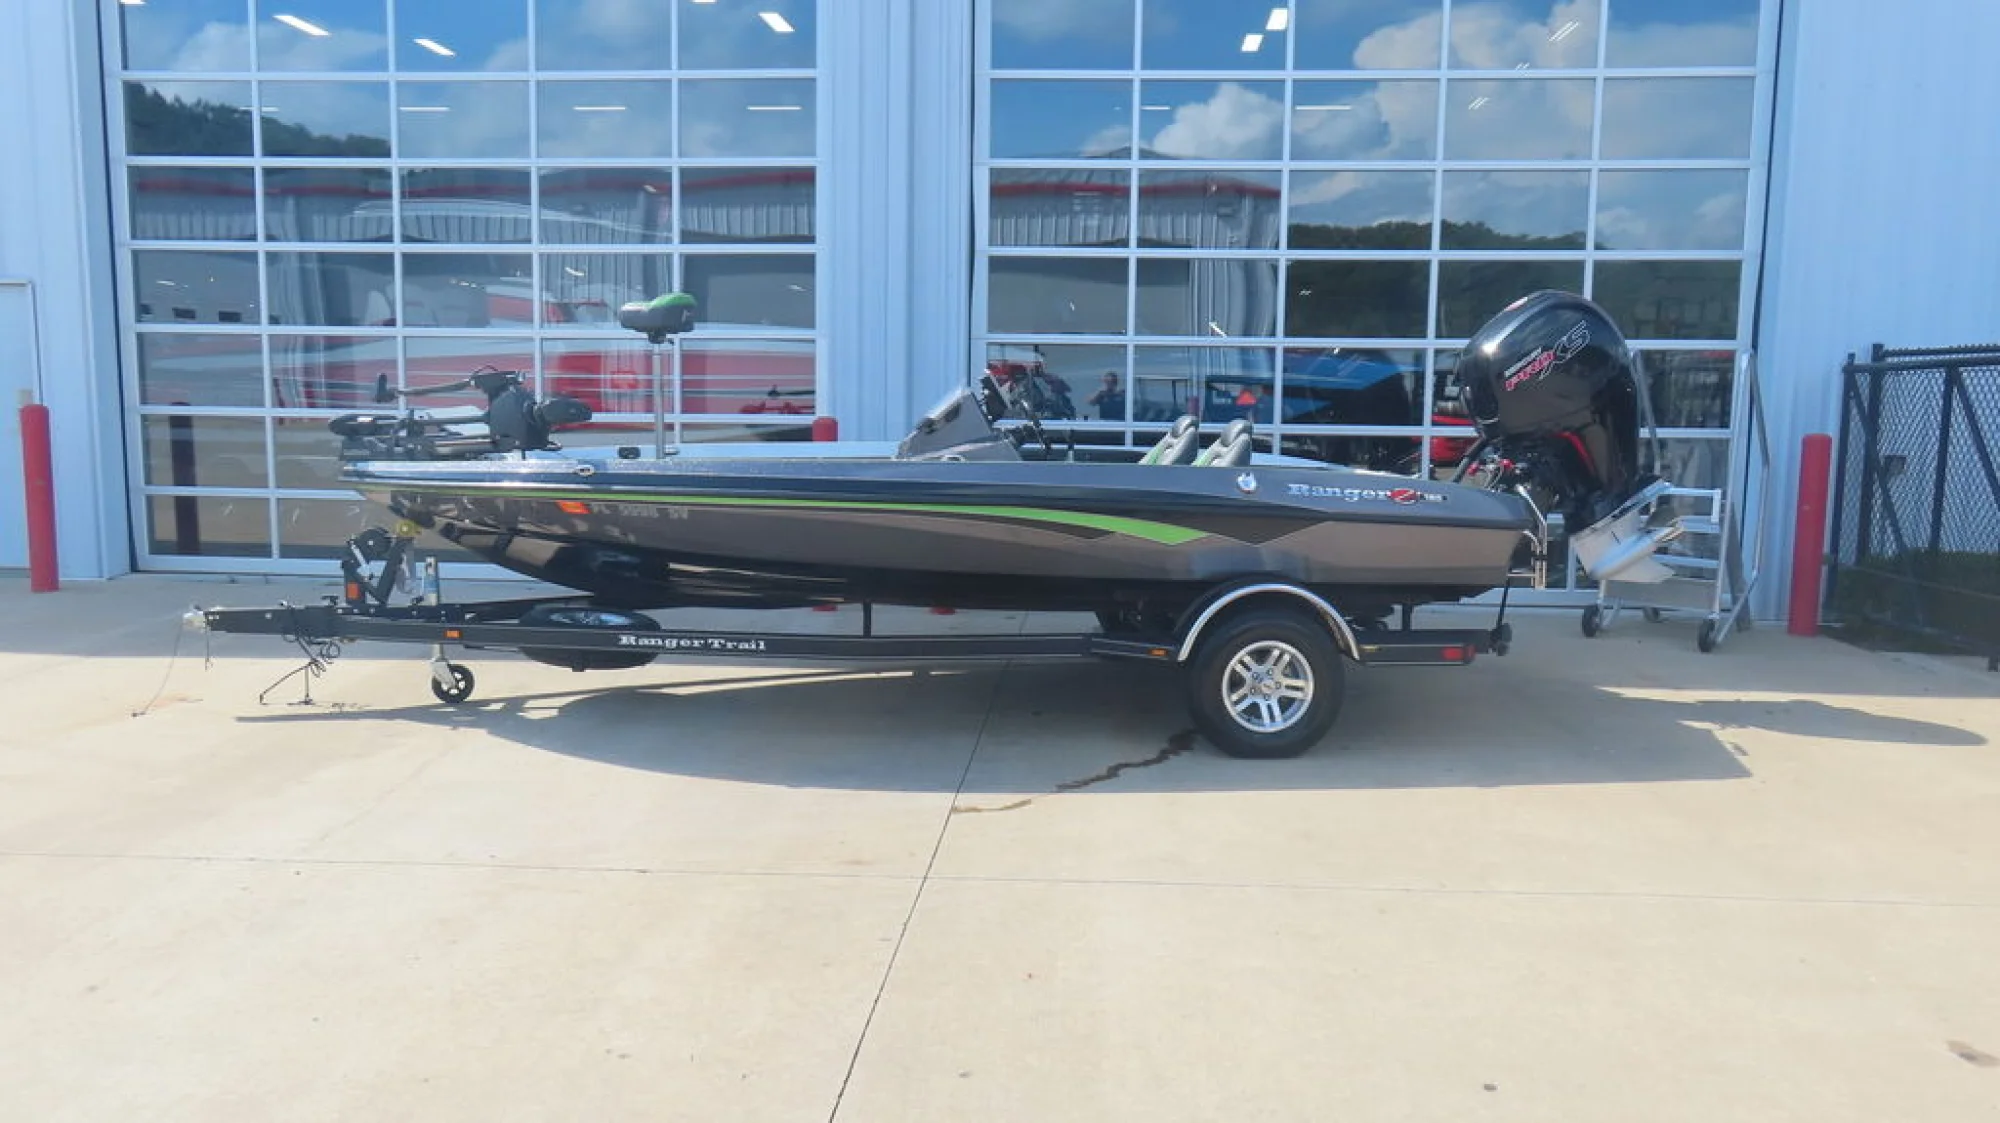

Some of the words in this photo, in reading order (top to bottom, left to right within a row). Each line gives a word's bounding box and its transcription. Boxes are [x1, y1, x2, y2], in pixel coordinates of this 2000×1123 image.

[1539, 320, 1591, 380] XS
[1287, 483, 1387, 502] Ranger
[618, 634, 704, 650] Ranger
[707, 638, 767, 651] Trail
